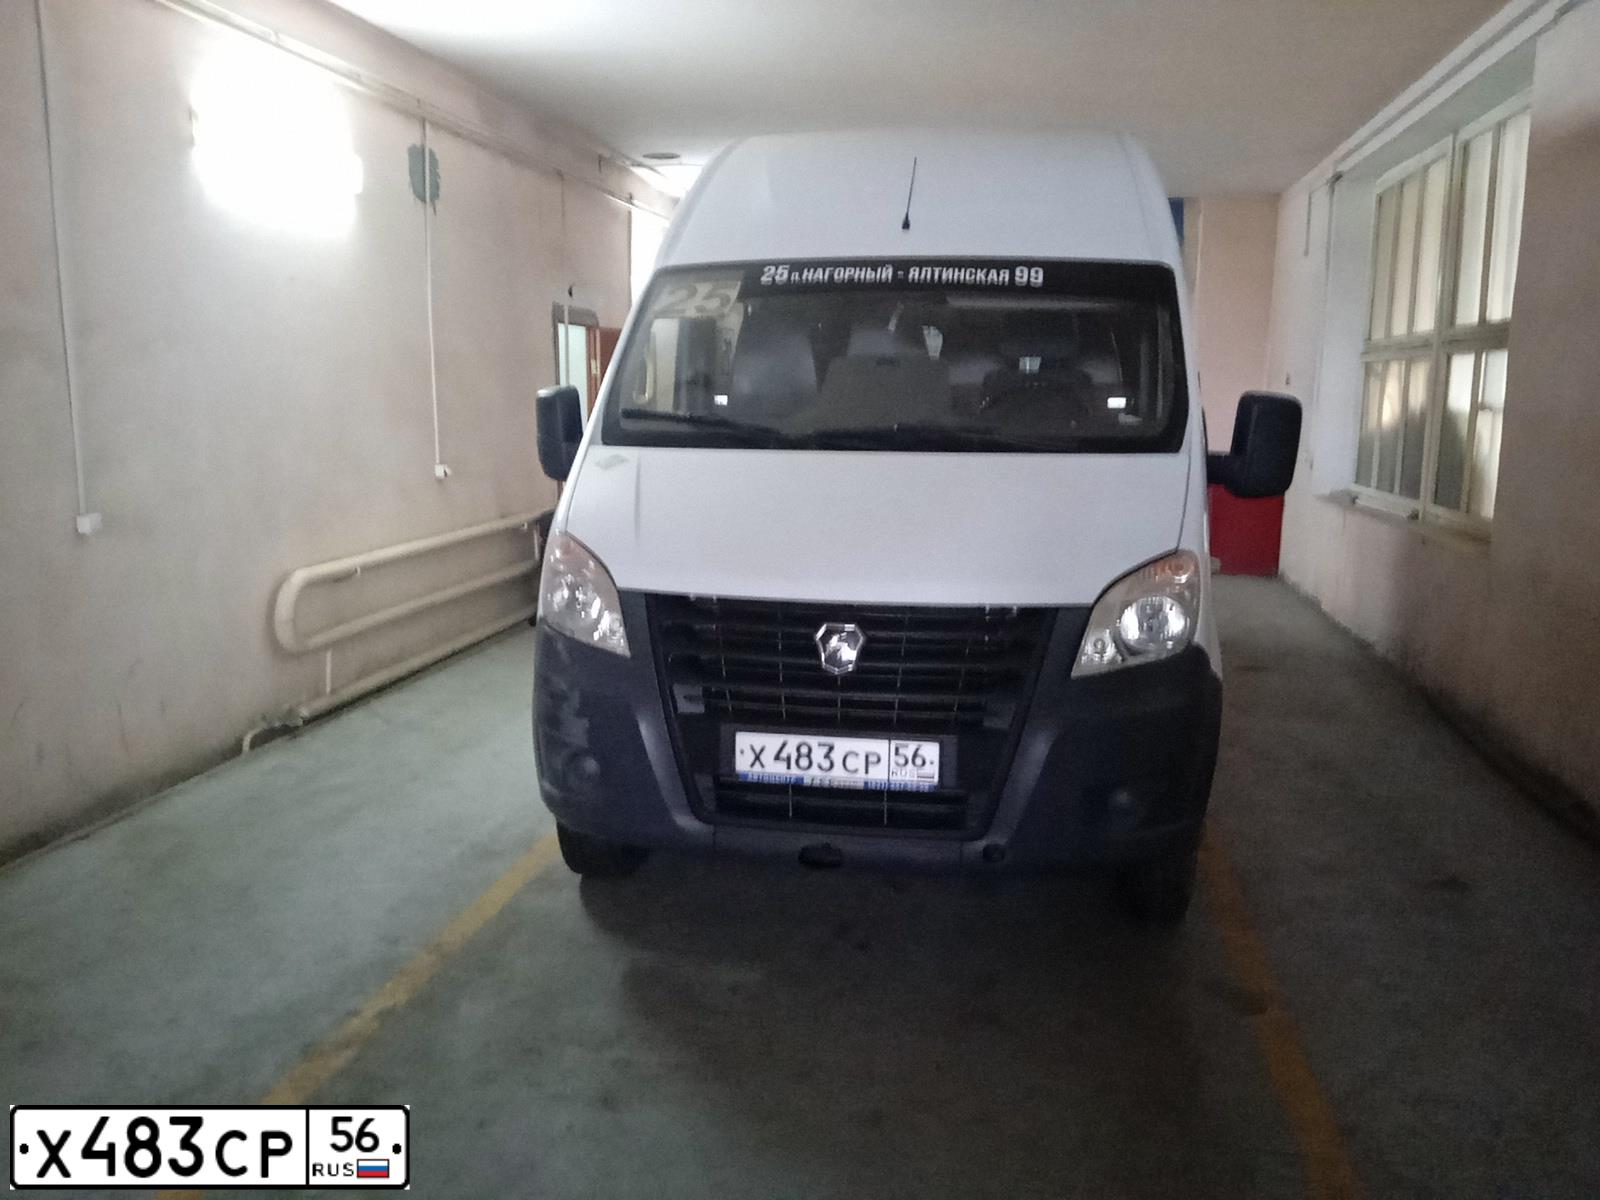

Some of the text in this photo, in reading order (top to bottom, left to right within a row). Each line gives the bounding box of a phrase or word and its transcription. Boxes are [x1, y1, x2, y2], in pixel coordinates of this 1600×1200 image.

[760, 265, 789, 285] 25
[908, 266, 1009, 286] ЯЛТИНСКАЯ
[1014, 266, 1044, 287] 99
[894, 742, 926, 768] 56
